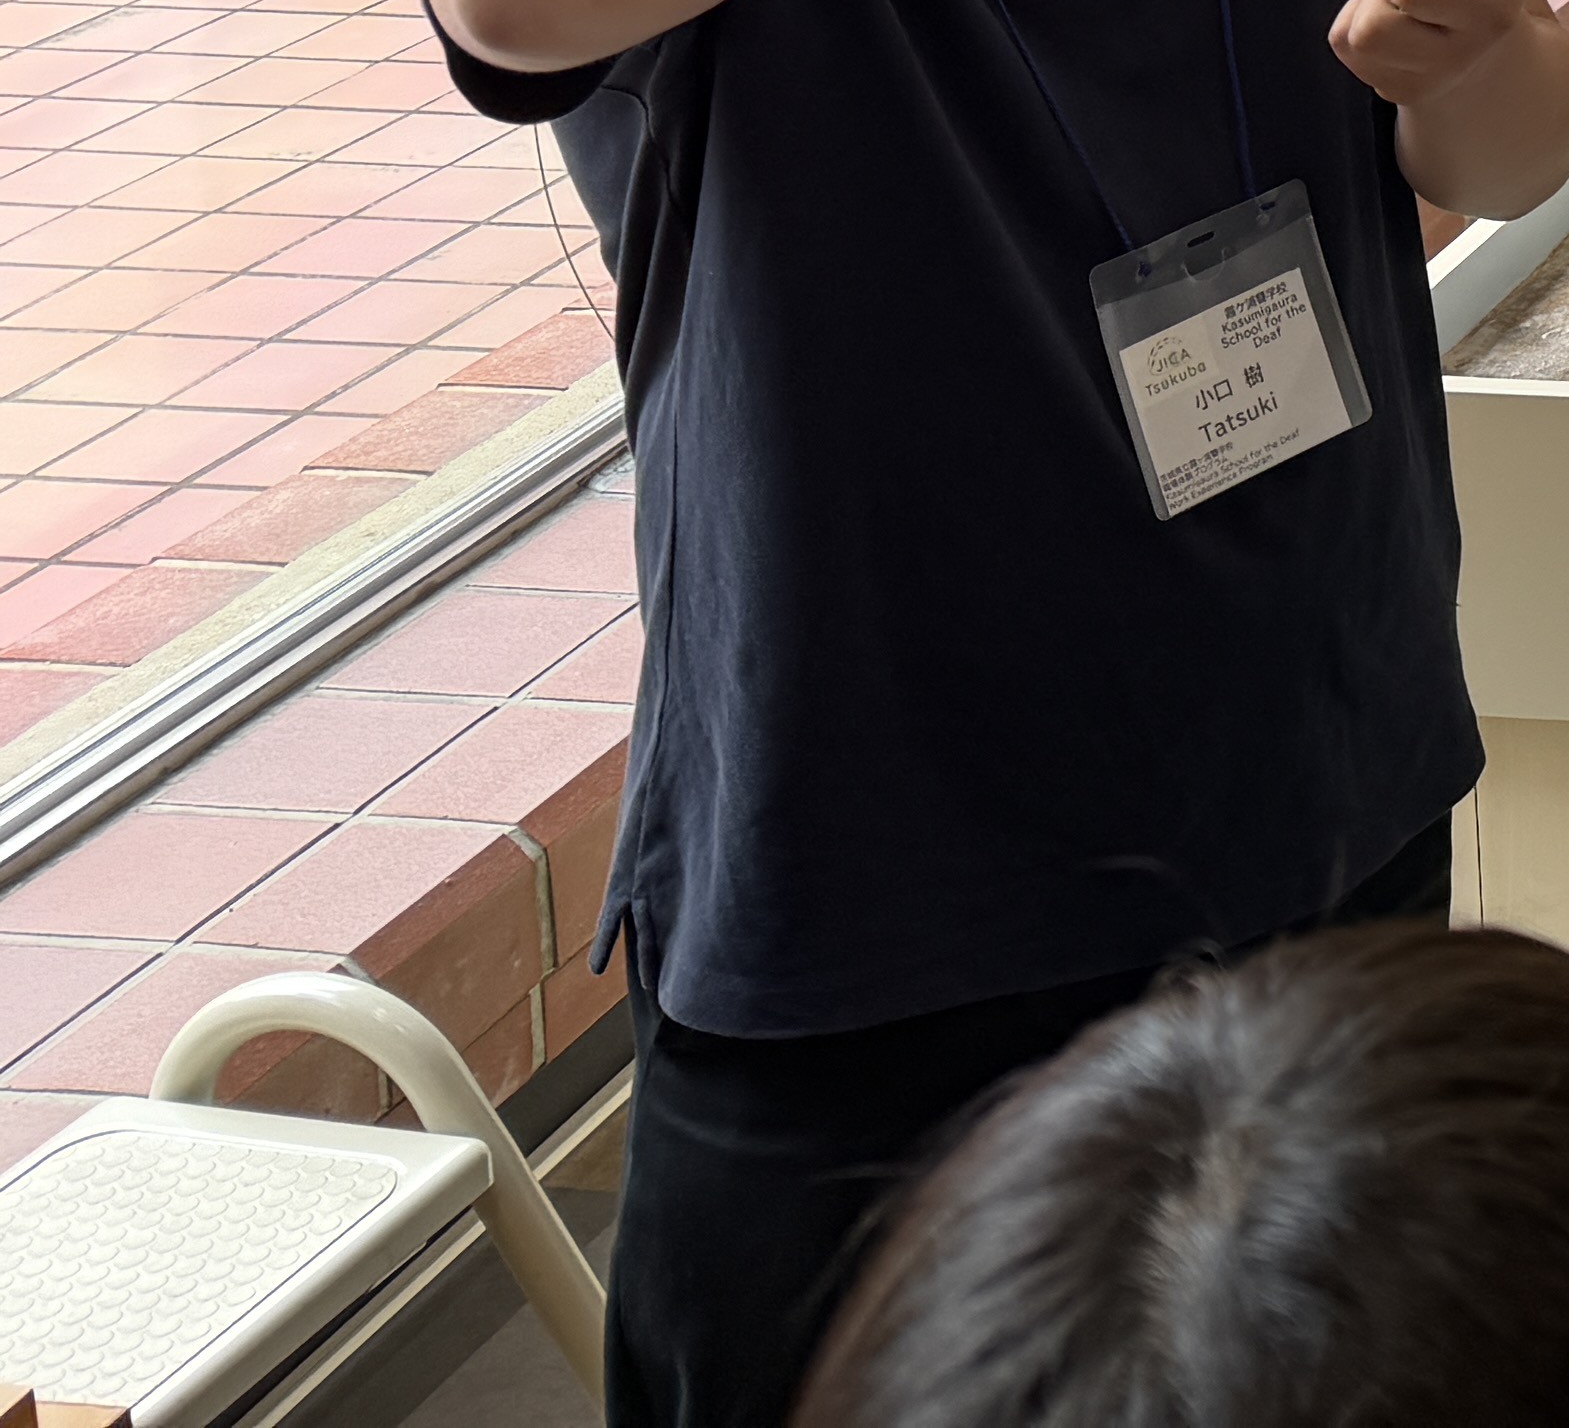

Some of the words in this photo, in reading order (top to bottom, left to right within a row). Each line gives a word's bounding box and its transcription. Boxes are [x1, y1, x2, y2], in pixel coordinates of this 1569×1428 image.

[1220, 321, 1263, 349] School
[1263, 313, 1282, 328] for
[1284, 303, 1306, 319] the
[1251, 325, 1281, 348] Deaf
[1144, 361, 1206, 396] Tsukuba
[1195, 378, 1233, 410] 小口
[1197, 390, 1277, 442] Tatsuki
